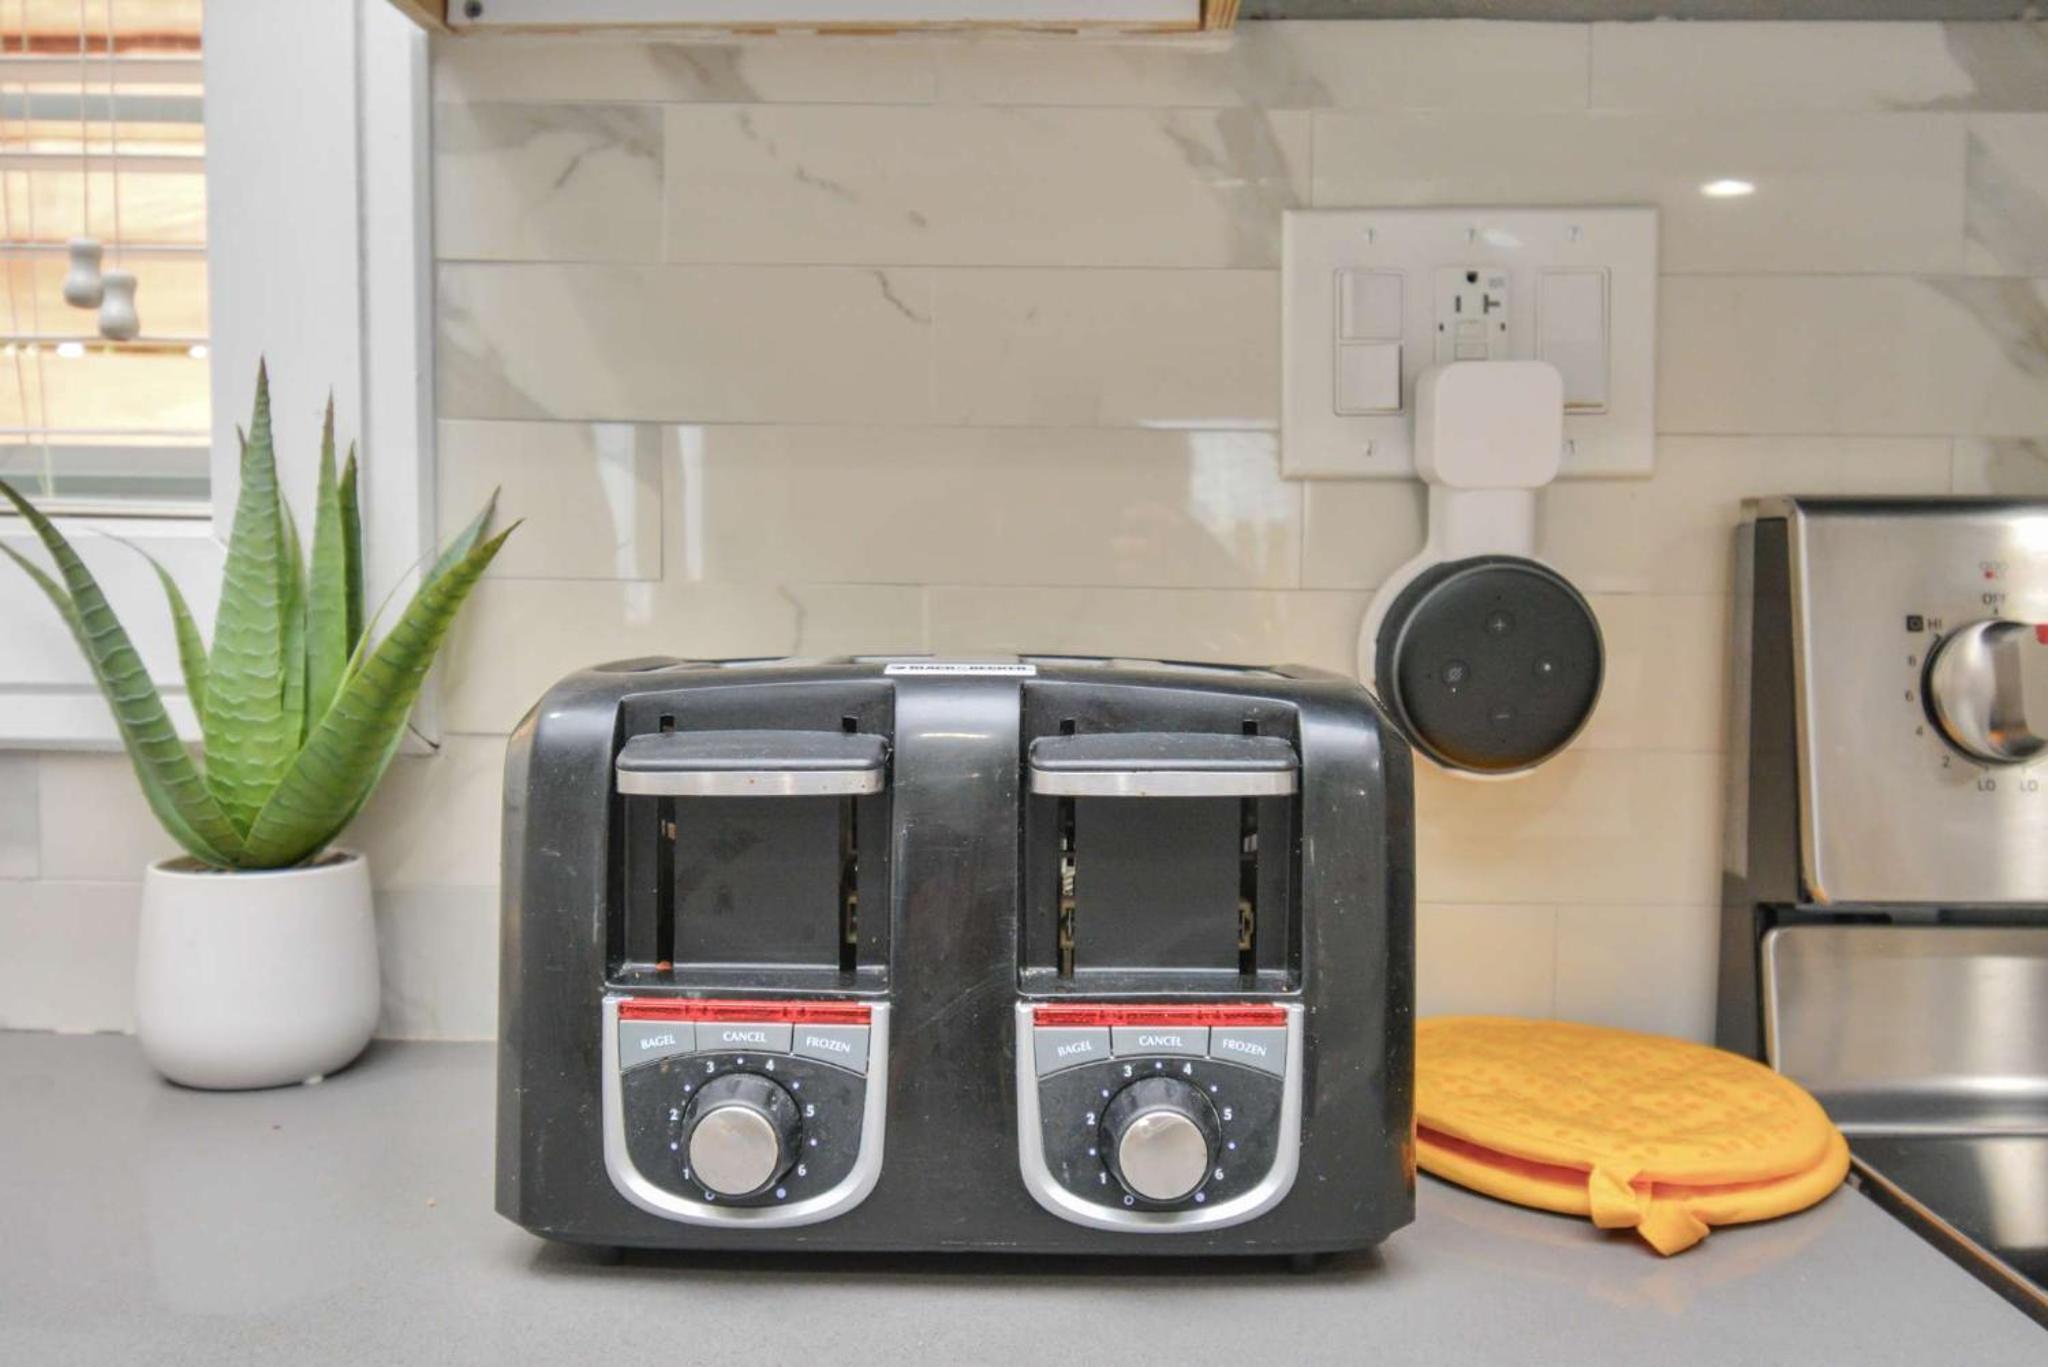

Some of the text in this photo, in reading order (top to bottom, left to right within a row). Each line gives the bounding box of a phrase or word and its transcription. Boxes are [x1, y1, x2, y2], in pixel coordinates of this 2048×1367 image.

[1942, 756, 1951, 769] 2
[1977, 779, 1996, 792] LO
[640, 1034, 677, 1050] BAGEL
[722, 1031, 767, 1043] CANCEL
[1138, 1035, 1183, 1047] CANCEL
[806, 1036, 851, 1053] FROZEN
[1057, 1040, 1092, 1057] BAGEL
[1222, 1038, 1267, 1056] FROZEN
[706, 1061, 715, 1073] 3
[765, 1059, 775, 1071] 4
[1124, 1064, 1133, 1078] 3
[1182, 1062, 1193, 1076] 4
[669, 1108, 679, 1121] 2
[806, 1104, 815, 1117] 5
[1223, 1108, 1233, 1121] 5
[1086, 1112, 1096, 1125] 2
[683, 1168, 690, 1180] 1
[798, 1164, 807, 1177] 6
[1214, 1168, 1224, 1180] 6
[1099, 1172, 1106, 1184] 1
